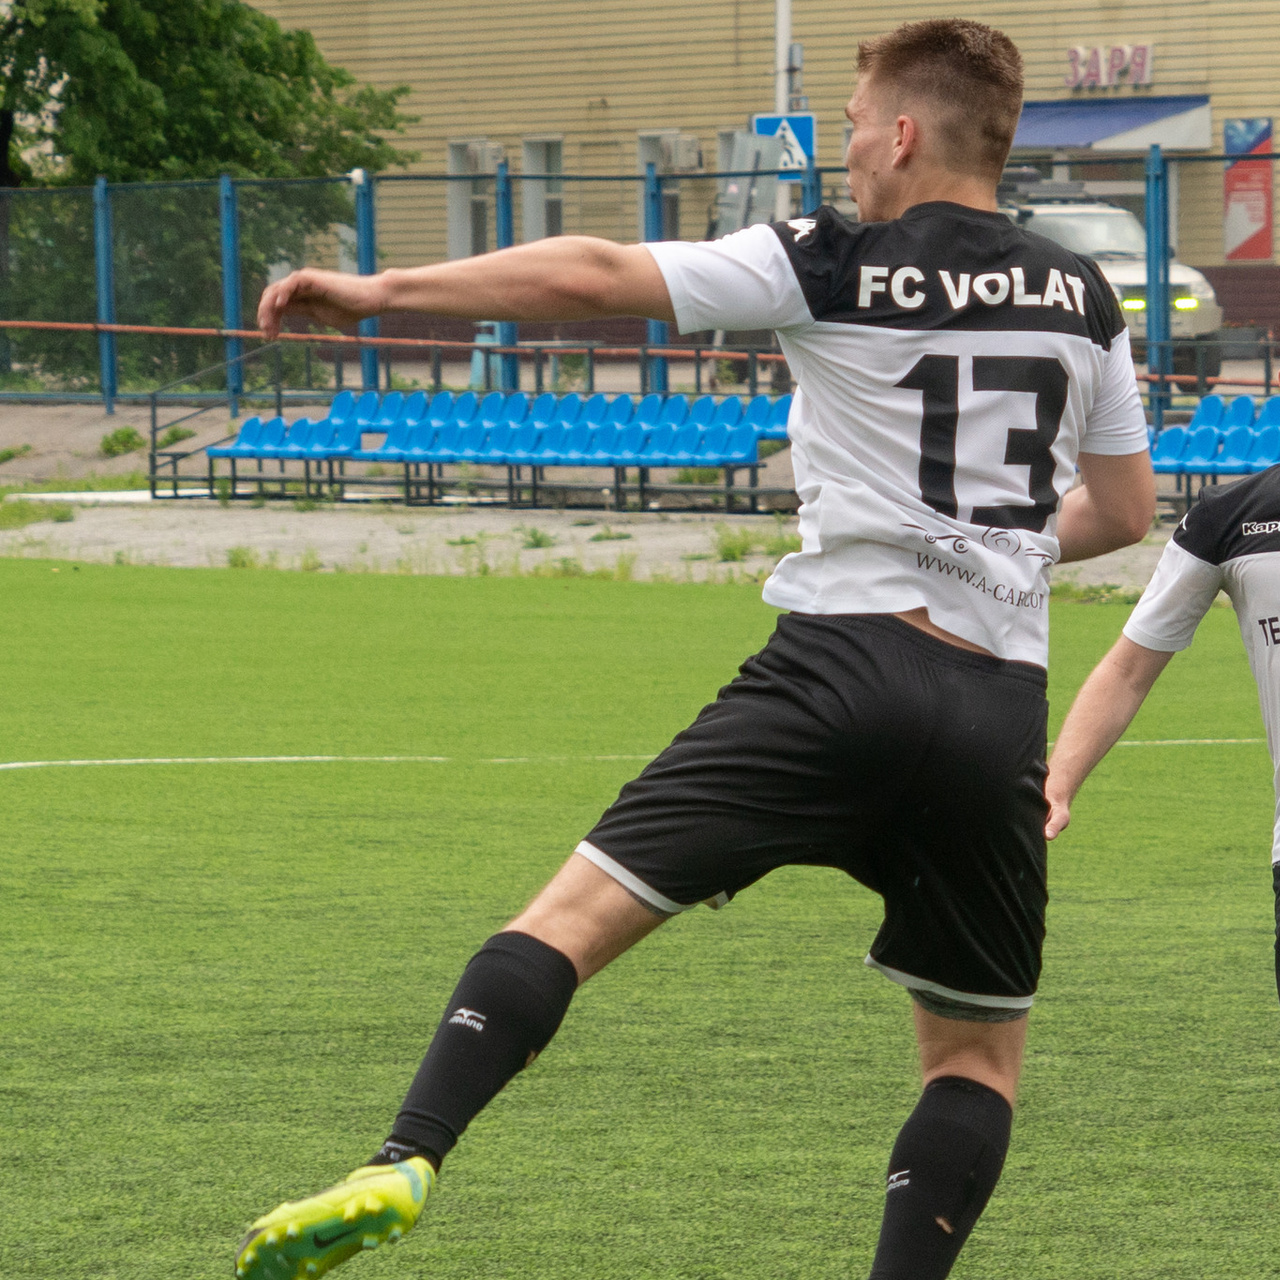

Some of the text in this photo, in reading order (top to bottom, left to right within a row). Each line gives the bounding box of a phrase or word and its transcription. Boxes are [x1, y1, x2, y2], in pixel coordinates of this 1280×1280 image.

[1064, 45, 1152, 87] ЗАРЯ
[857, 266, 1085, 316] FC VOLAT
[894, 353, 1070, 532] 13
